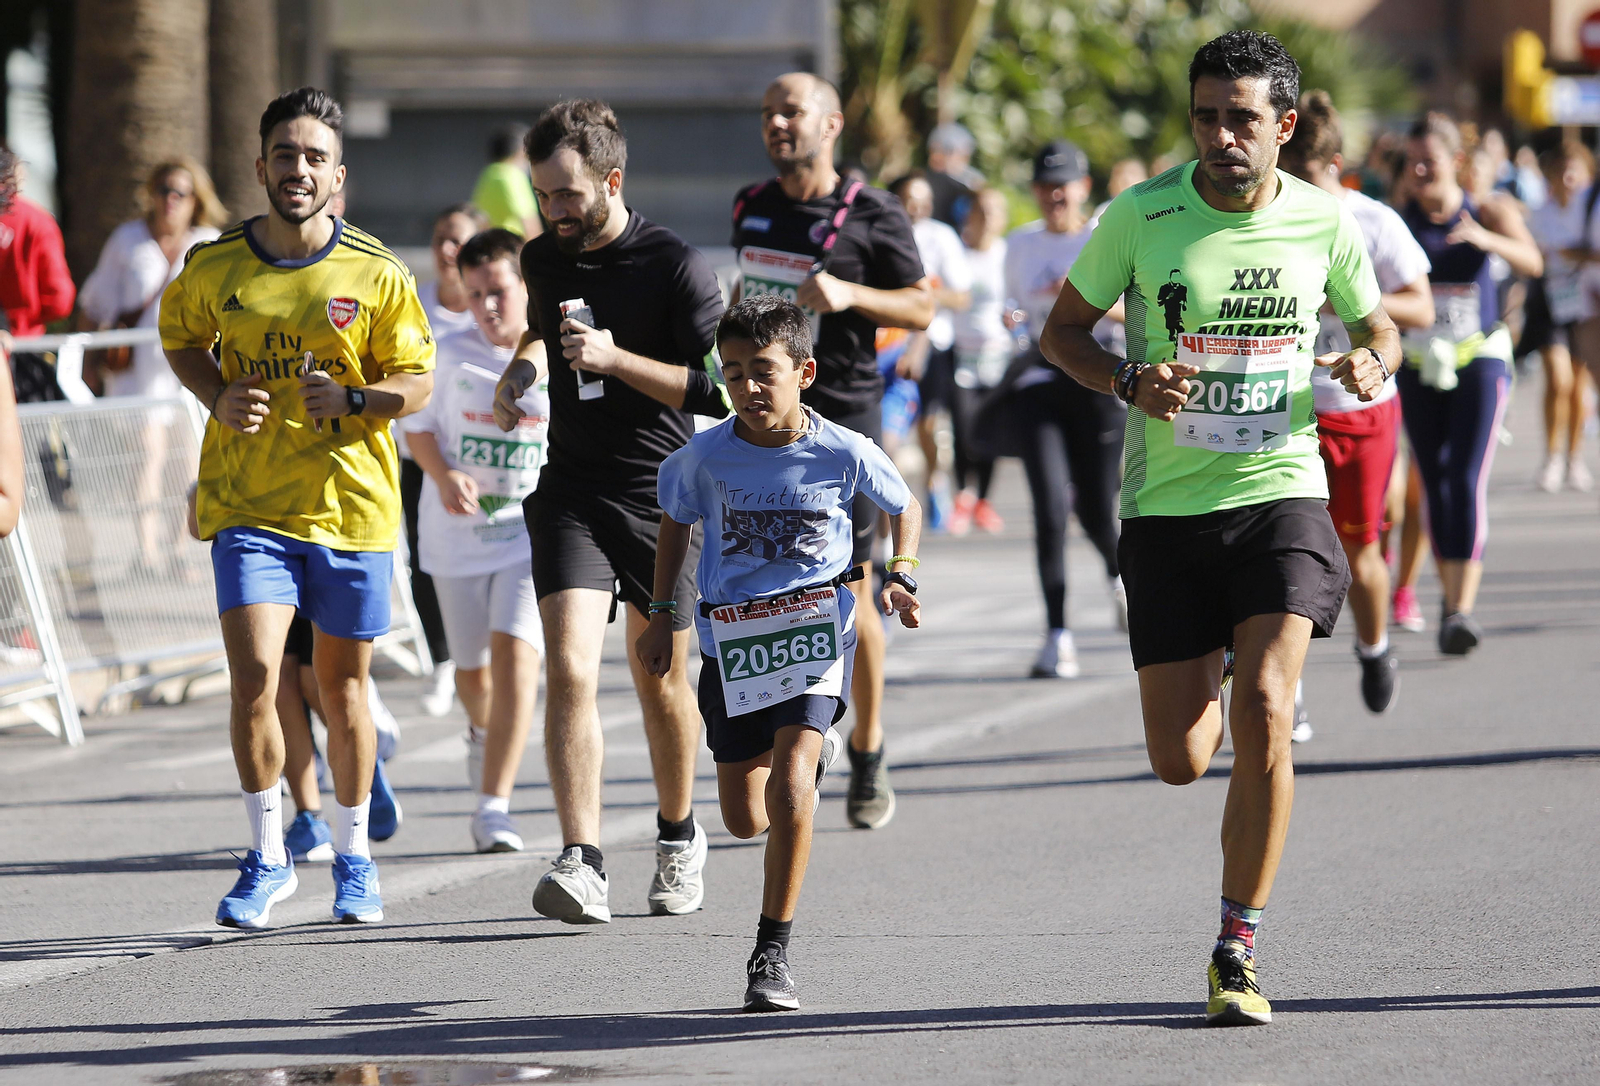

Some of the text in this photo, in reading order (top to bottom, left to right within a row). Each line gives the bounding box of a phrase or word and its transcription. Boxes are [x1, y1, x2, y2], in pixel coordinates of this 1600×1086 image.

[1145, 206, 1175, 222] luanvi
[1229, 267, 1282, 291] XXX
[1218, 296, 1298, 319] MEDIA
[264, 331, 302, 352] Fly
[1182, 336, 1205, 353] 41
[1206, 337, 1259, 349] CARRERA
[1262, 337, 1297, 348] URBANA
[1207, 347, 1239, 356] CIUDAD
[1241, 348, 1252, 356] DE
[1184, 379, 1285, 414] 20567
[462, 439, 540, 469] 23140
[728, 485, 822, 507] Triatlón
[713, 607, 737, 624] 41
[739, 611, 769, 622] CIUDAD
[771, 608, 782, 617] DE
[804, 613, 831, 621] CARRERA
[727, 632, 831, 679] 20568
